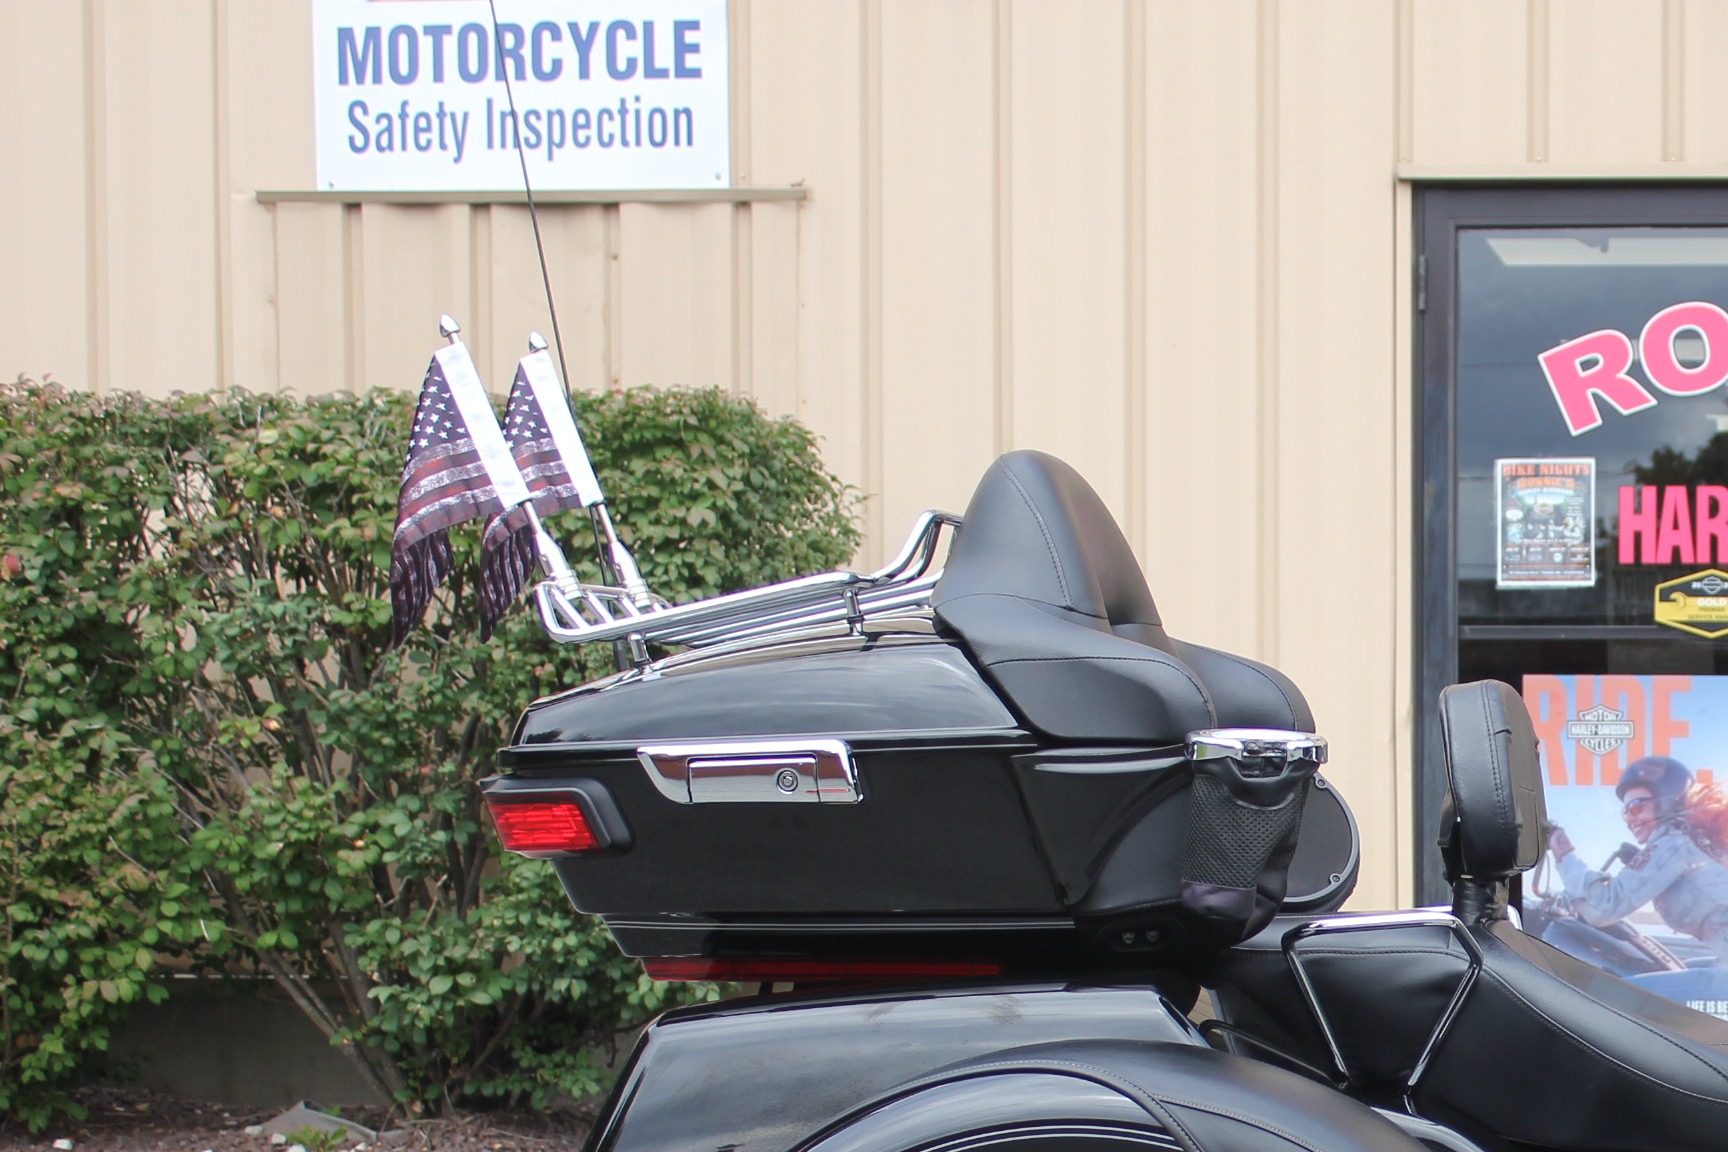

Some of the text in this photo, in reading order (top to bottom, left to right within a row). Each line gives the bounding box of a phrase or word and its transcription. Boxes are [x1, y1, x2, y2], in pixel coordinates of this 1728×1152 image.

[337, 20, 703, 86] MOTORCYCLE
[347, 94, 695, 164] Safety Inspection
[1696, 597, 1728, 607] GOLD
[1584, 709, 1617, 721] MOTOR
[1571, 723, 1631, 736] HARLEY-DAVIDSON
[1584, 739, 1617, 751] CYCLES
[1706, 1000, 1716, 1014] IS
